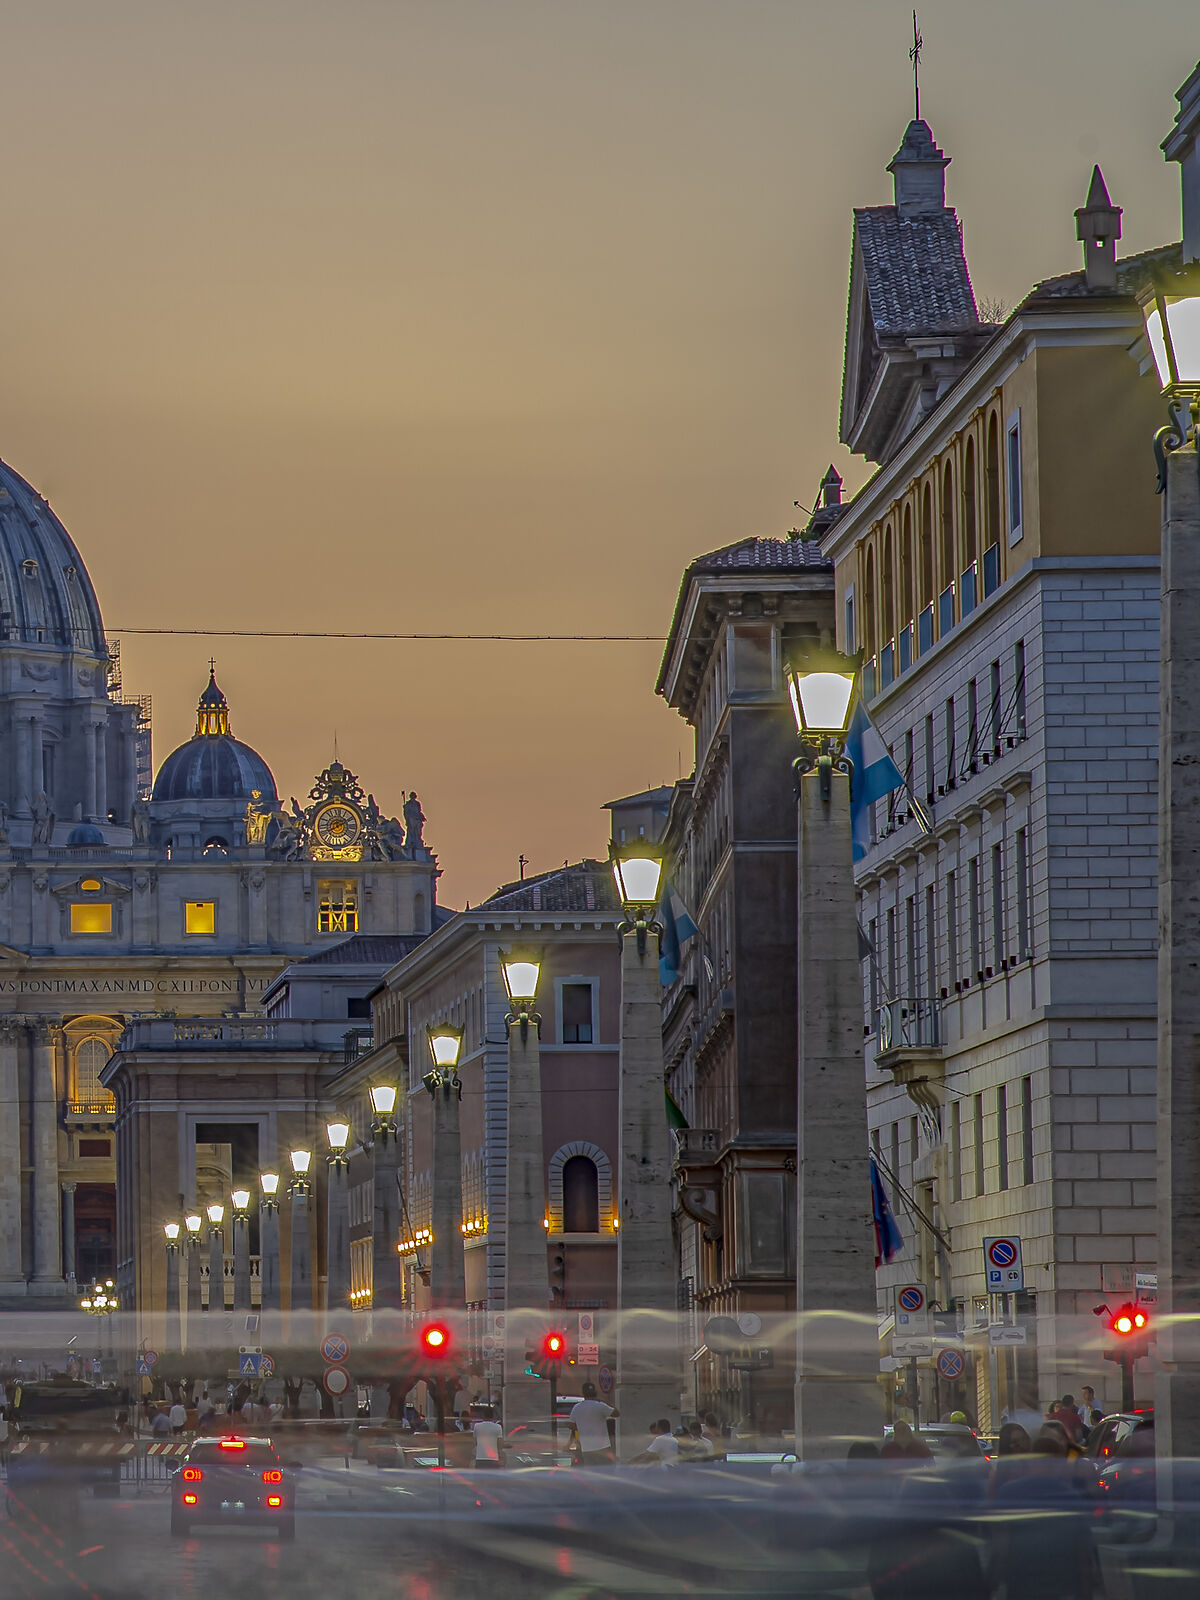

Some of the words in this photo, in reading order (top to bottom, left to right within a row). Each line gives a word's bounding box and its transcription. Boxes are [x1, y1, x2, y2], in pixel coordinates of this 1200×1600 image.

[20, 980, 63, 993] PONT
[64, 980, 99, 992] MAX
[102, 980, 124, 992] AN
[128, 980, 194, 992] MDCXII
[199, 980, 241, 992] PONT
[1008, 1272, 1018, 1280] CD
